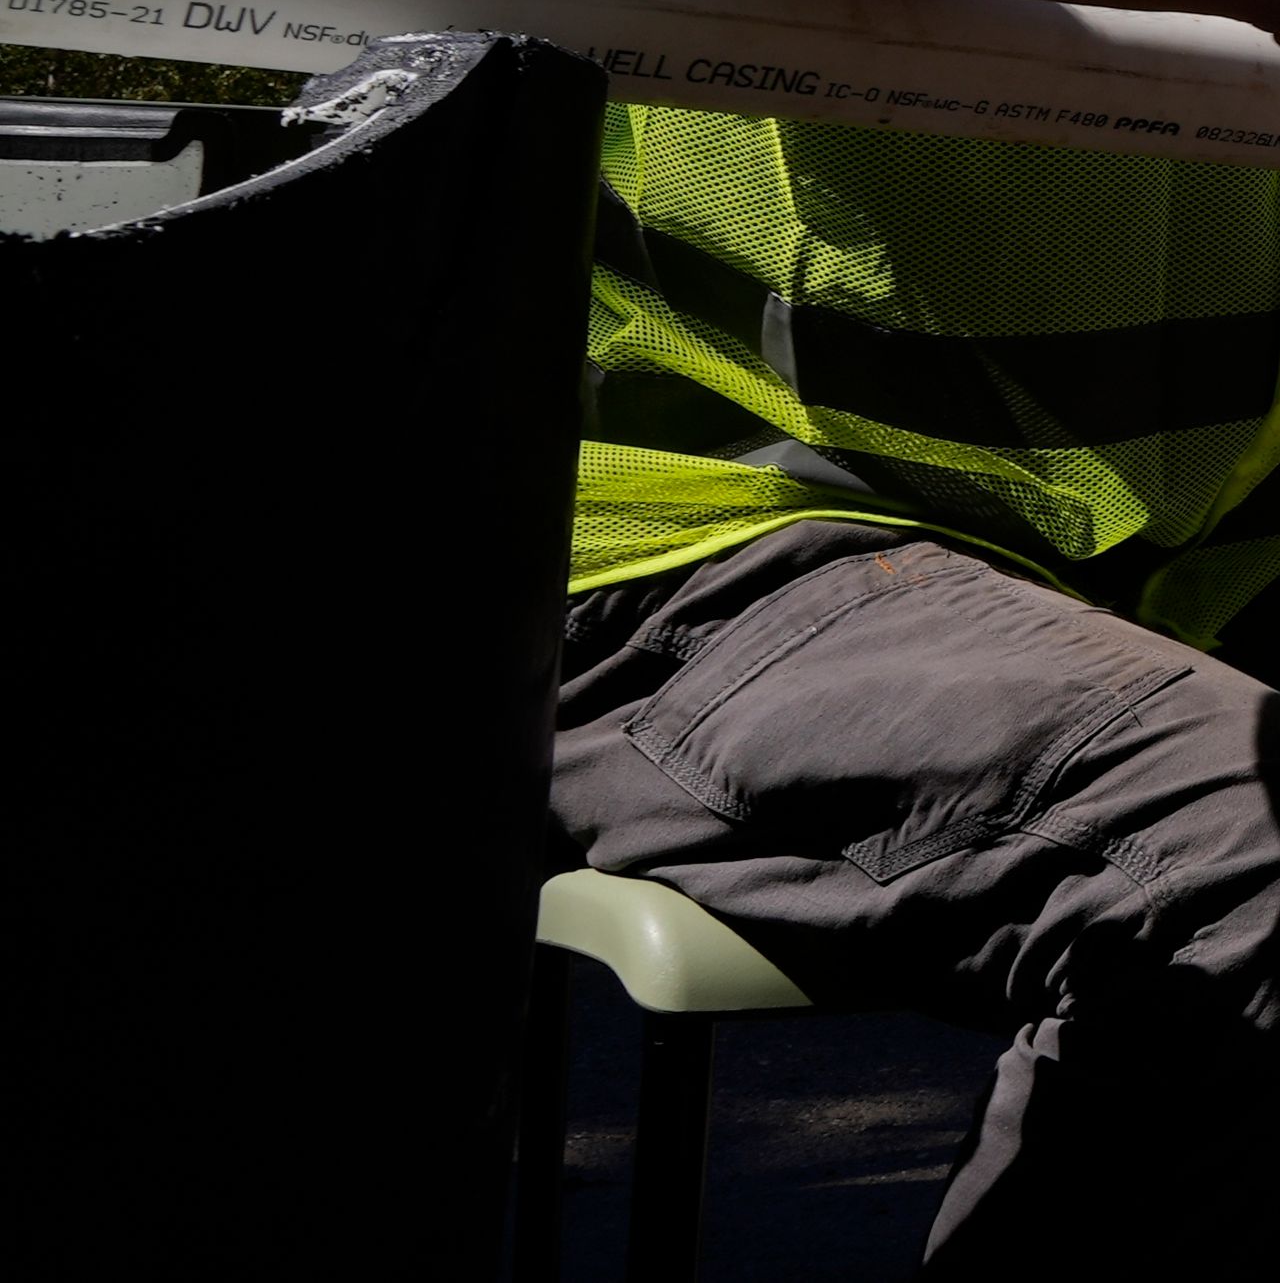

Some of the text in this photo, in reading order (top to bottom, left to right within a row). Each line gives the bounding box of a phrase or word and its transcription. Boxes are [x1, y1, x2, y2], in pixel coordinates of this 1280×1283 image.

[183, 1, 276, 36] DWV
[685, 56, 821, 96] CASING
[994, 103, 1052, 122] ASTM
[1056, 111, 1109, 129] F480
[1114, 117, 1181, 137] PPFA
